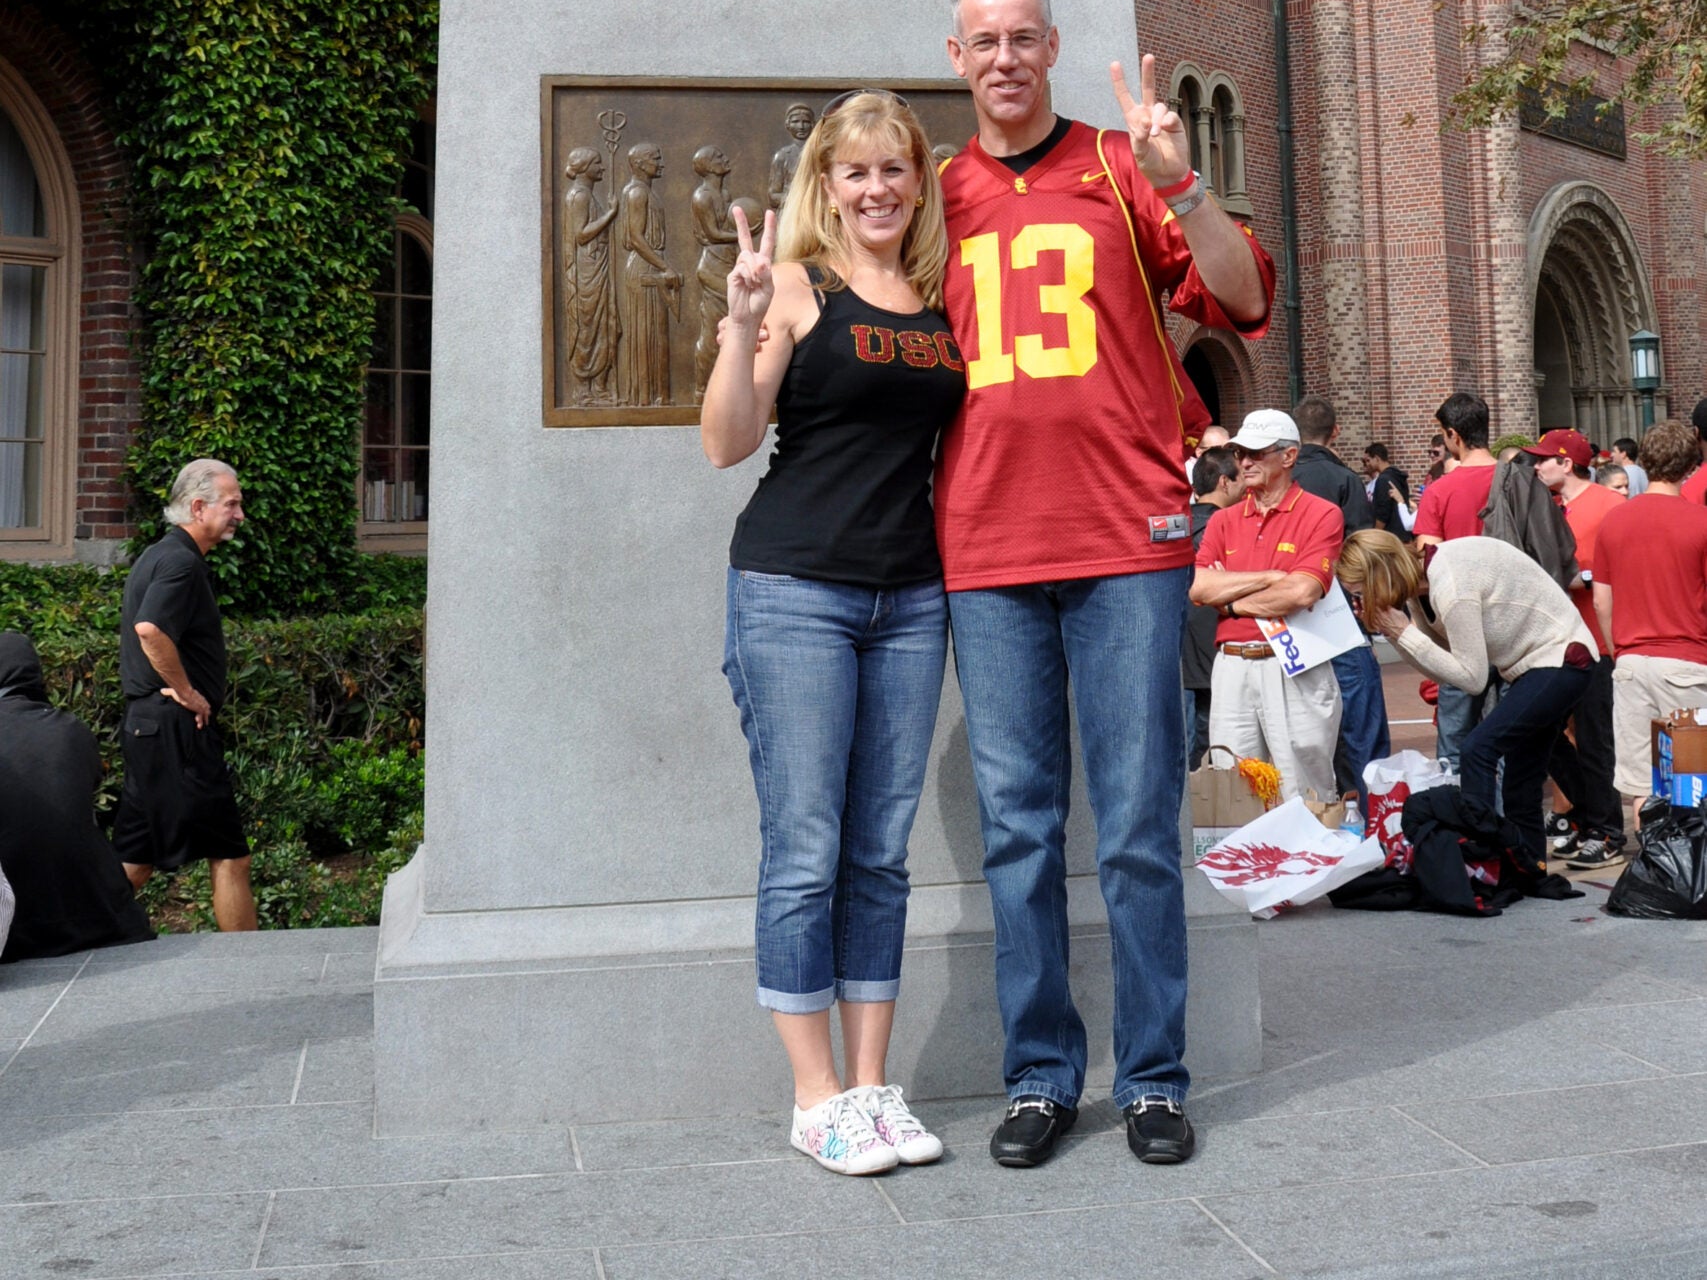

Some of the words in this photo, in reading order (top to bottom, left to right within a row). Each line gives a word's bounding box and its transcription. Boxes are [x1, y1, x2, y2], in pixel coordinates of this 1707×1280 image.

[960, 223, 1098, 390] 13
[850, 324, 965, 372] USC
[1264, 616, 1306, 676] FedE
